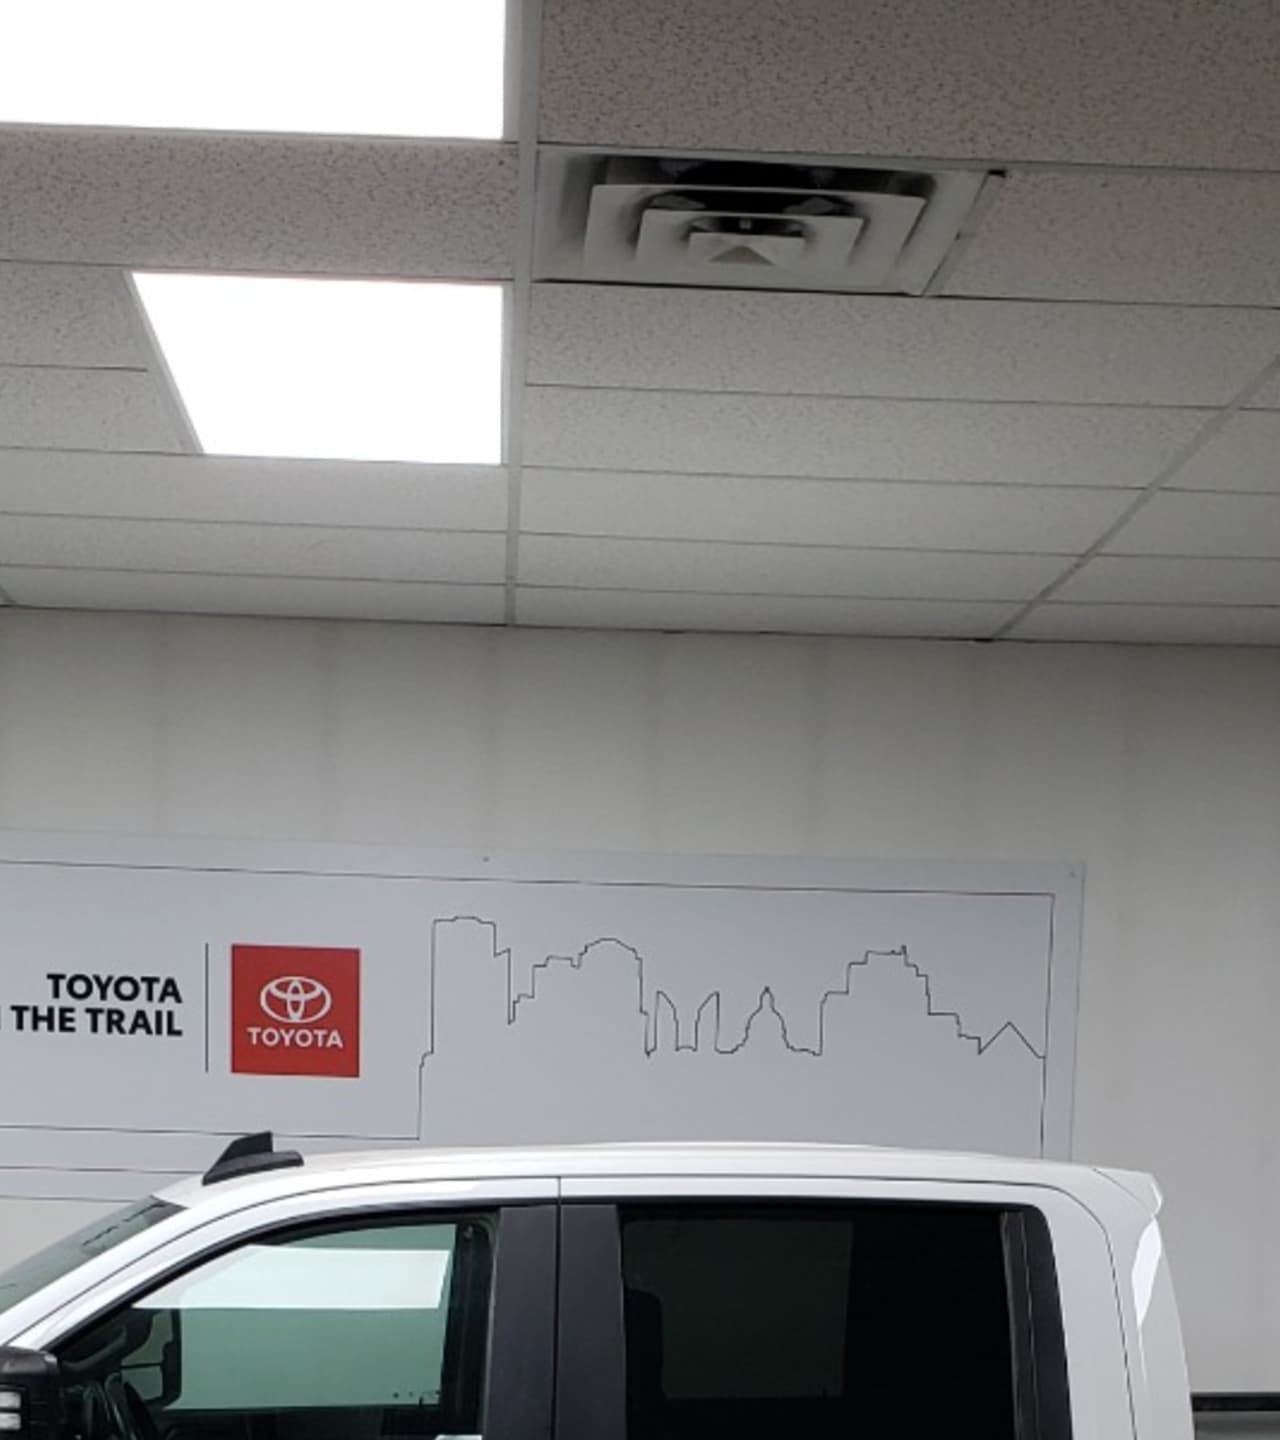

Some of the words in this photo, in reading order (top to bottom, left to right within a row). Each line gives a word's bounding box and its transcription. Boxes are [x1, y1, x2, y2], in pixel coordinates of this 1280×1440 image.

[46, 973, 183, 1004] TOYOTA
[9, 1004, 77, 1033] THE
[84, 1007, 183, 1037] TRAIL
[247, 1027, 344, 1048] TOYOTA
